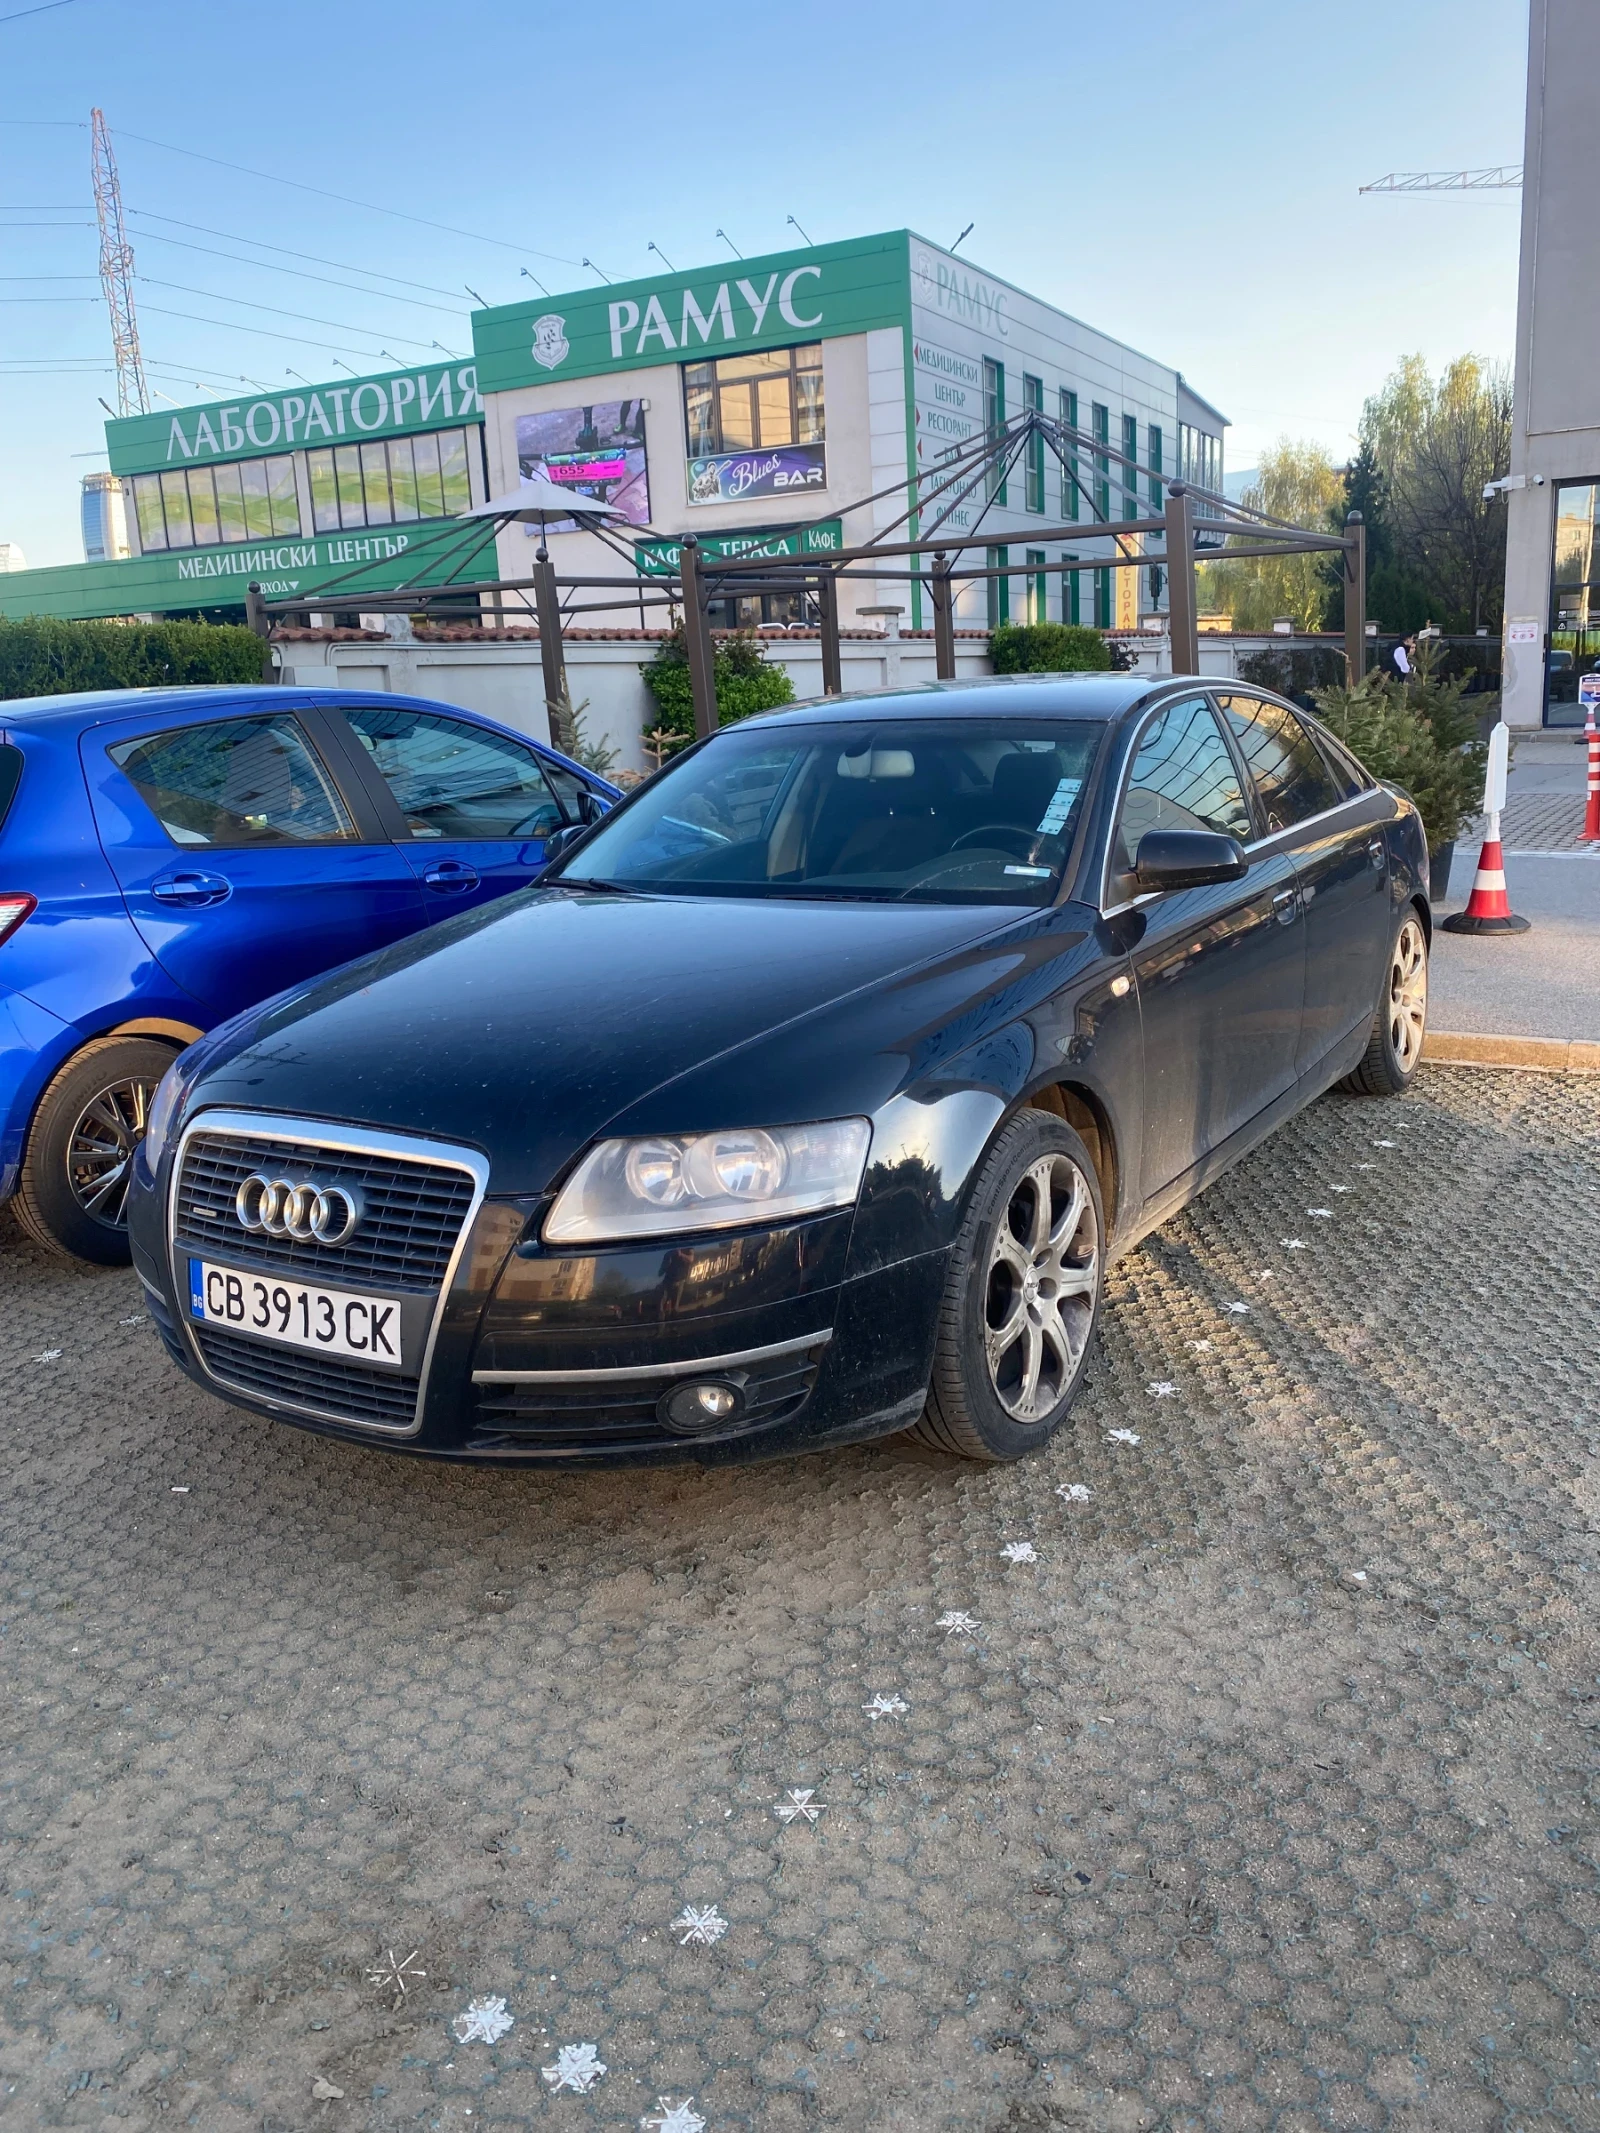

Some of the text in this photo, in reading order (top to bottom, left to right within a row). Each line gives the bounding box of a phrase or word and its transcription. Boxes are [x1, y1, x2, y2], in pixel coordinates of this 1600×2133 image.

[608, 266, 823, 358] РАМУС
[936, 262, 1008, 336] РАМУС
[919, 346, 978, 383] МЕДИЦИНСКИ
[934, 382, 966, 408] ЦЕНТЪР
[166, 366, 483, 461] ЛАБОРАТОРИЯ
[927, 410, 972, 438] РЕСТОРАНТ
[559, 466, 585, 475] 655
[728, 453, 781, 496] Blues
[773, 467, 823, 487] BAR
[808, 530, 836, 550] КАФЕ
[178, 535, 409, 579] МЕДИЦИНСКИ ЦЕНТЪР
[260, 580, 289, 594] ВХОД
[193, 1294, 203, 1309] BG
[207, 1271, 395, 1356] CB 3913 CK
